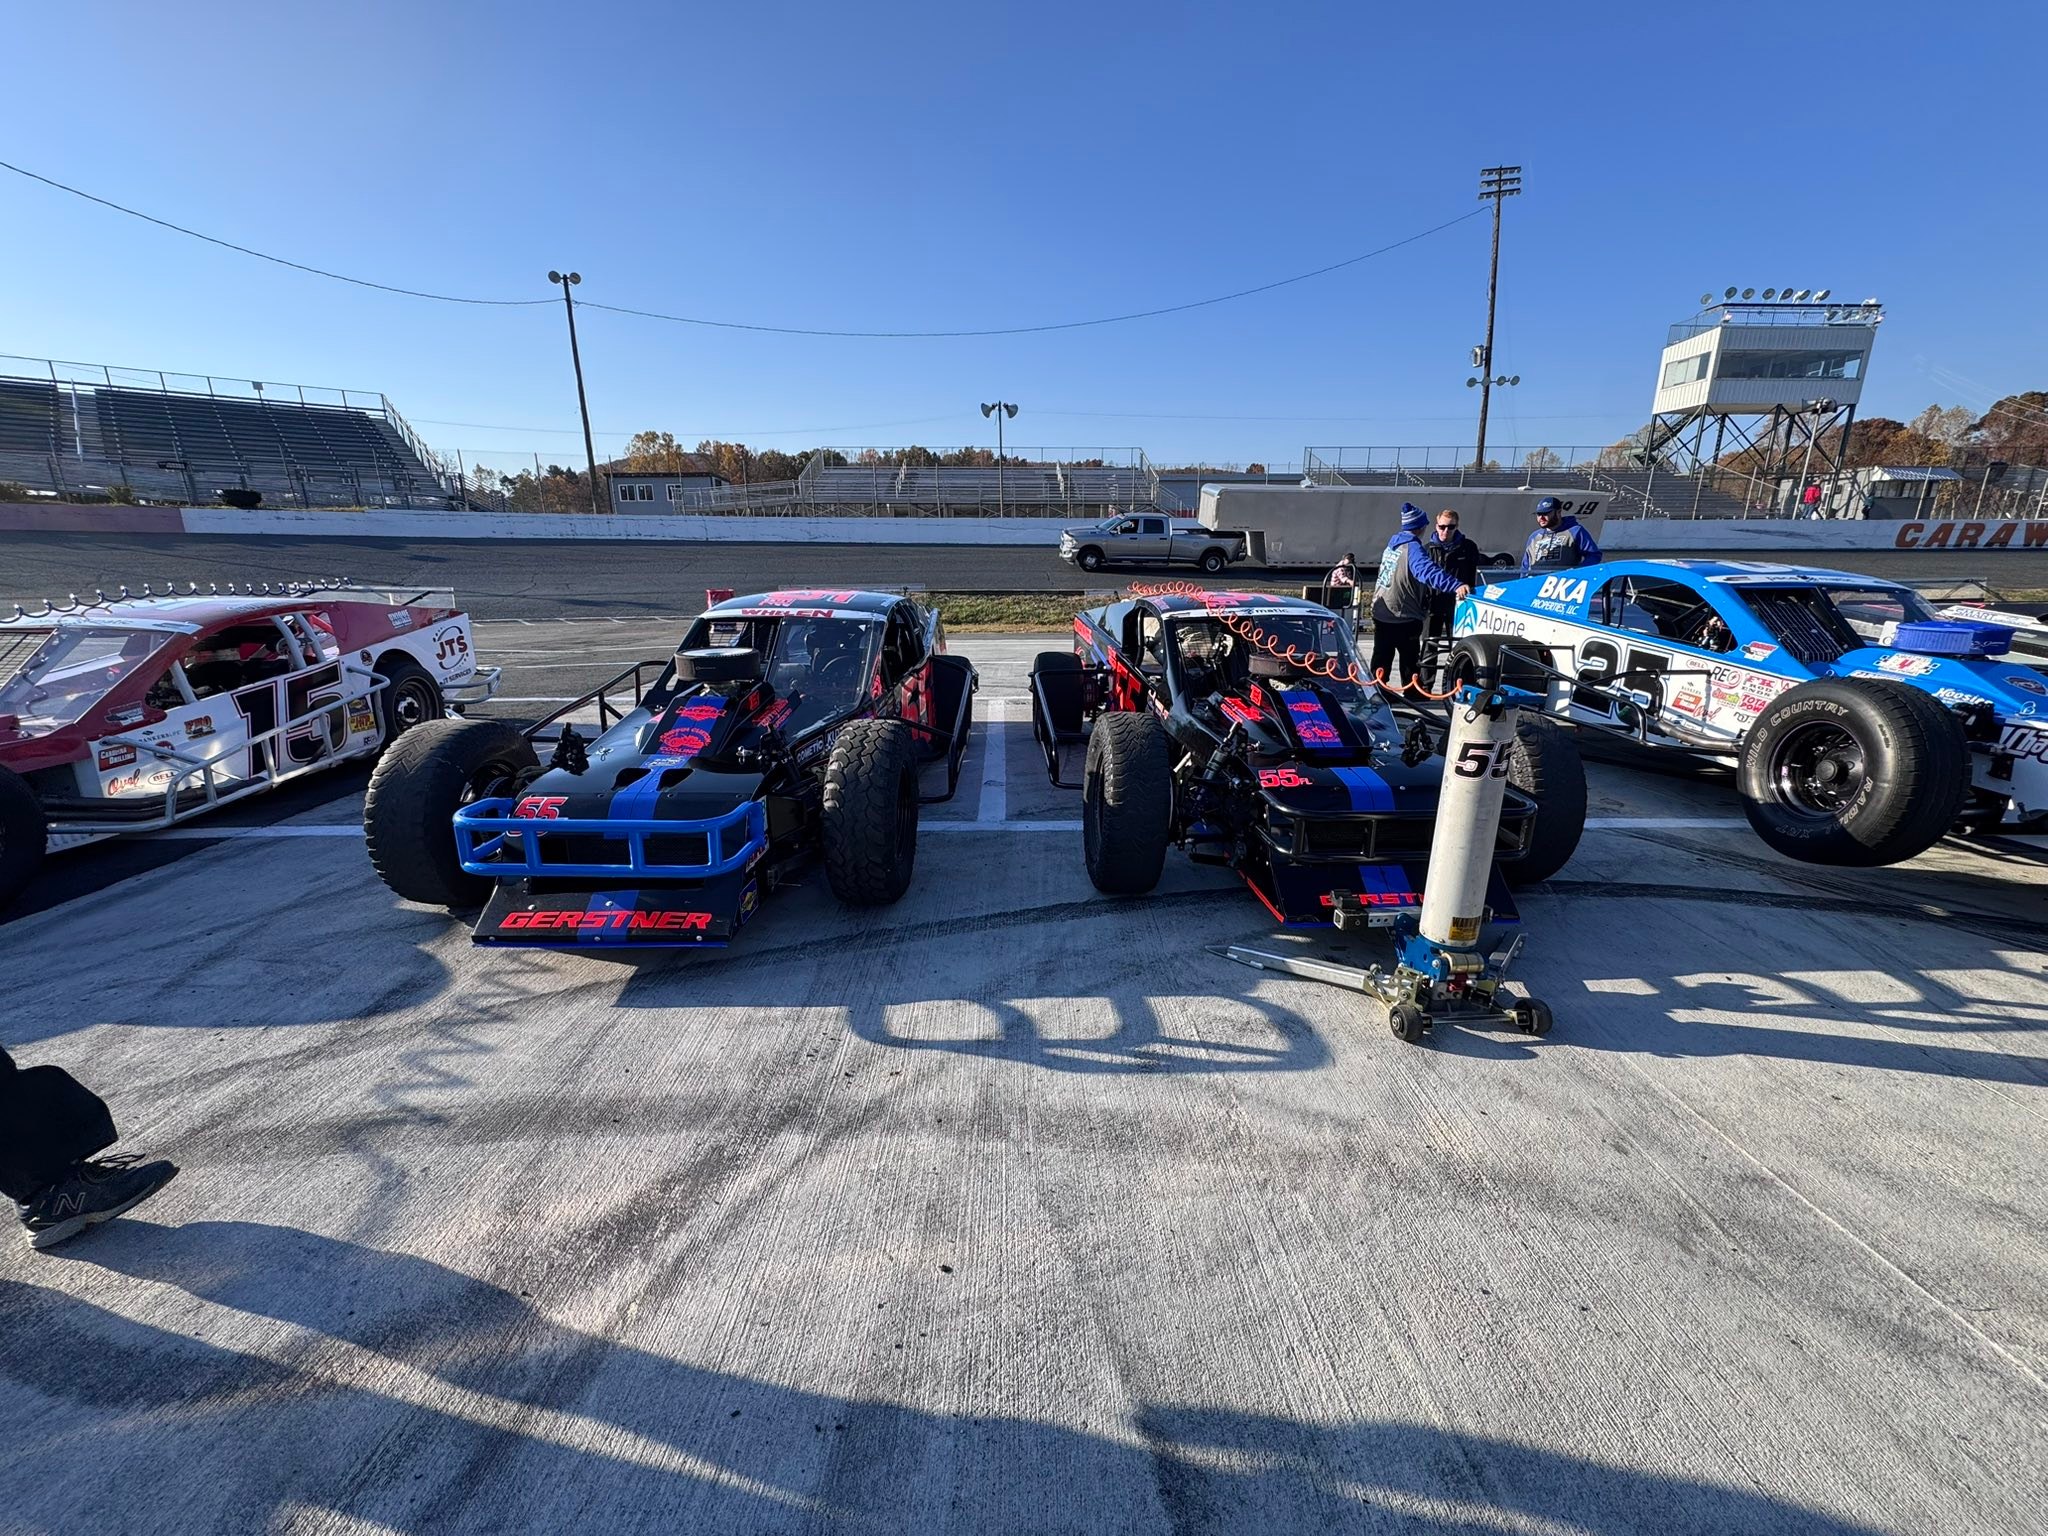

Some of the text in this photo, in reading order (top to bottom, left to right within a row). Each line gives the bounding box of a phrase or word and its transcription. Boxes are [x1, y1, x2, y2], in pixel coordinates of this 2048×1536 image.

[1575, 501, 1600, 515] 19
[1537, 575, 1588, 604] BKA
[741, 608, 833, 618] WHELEN
[1478, 610, 1526, 637] Alpine
[436, 635, 468, 661] JTS
[230, 660, 348, 780] 15
[1746, 727, 1768, 769] WILD
[1770, 699, 1849, 728] COUNTRY
[1823, 776, 1874, 834] RADIAL
[498, 911, 712, 929] GERSTNER
